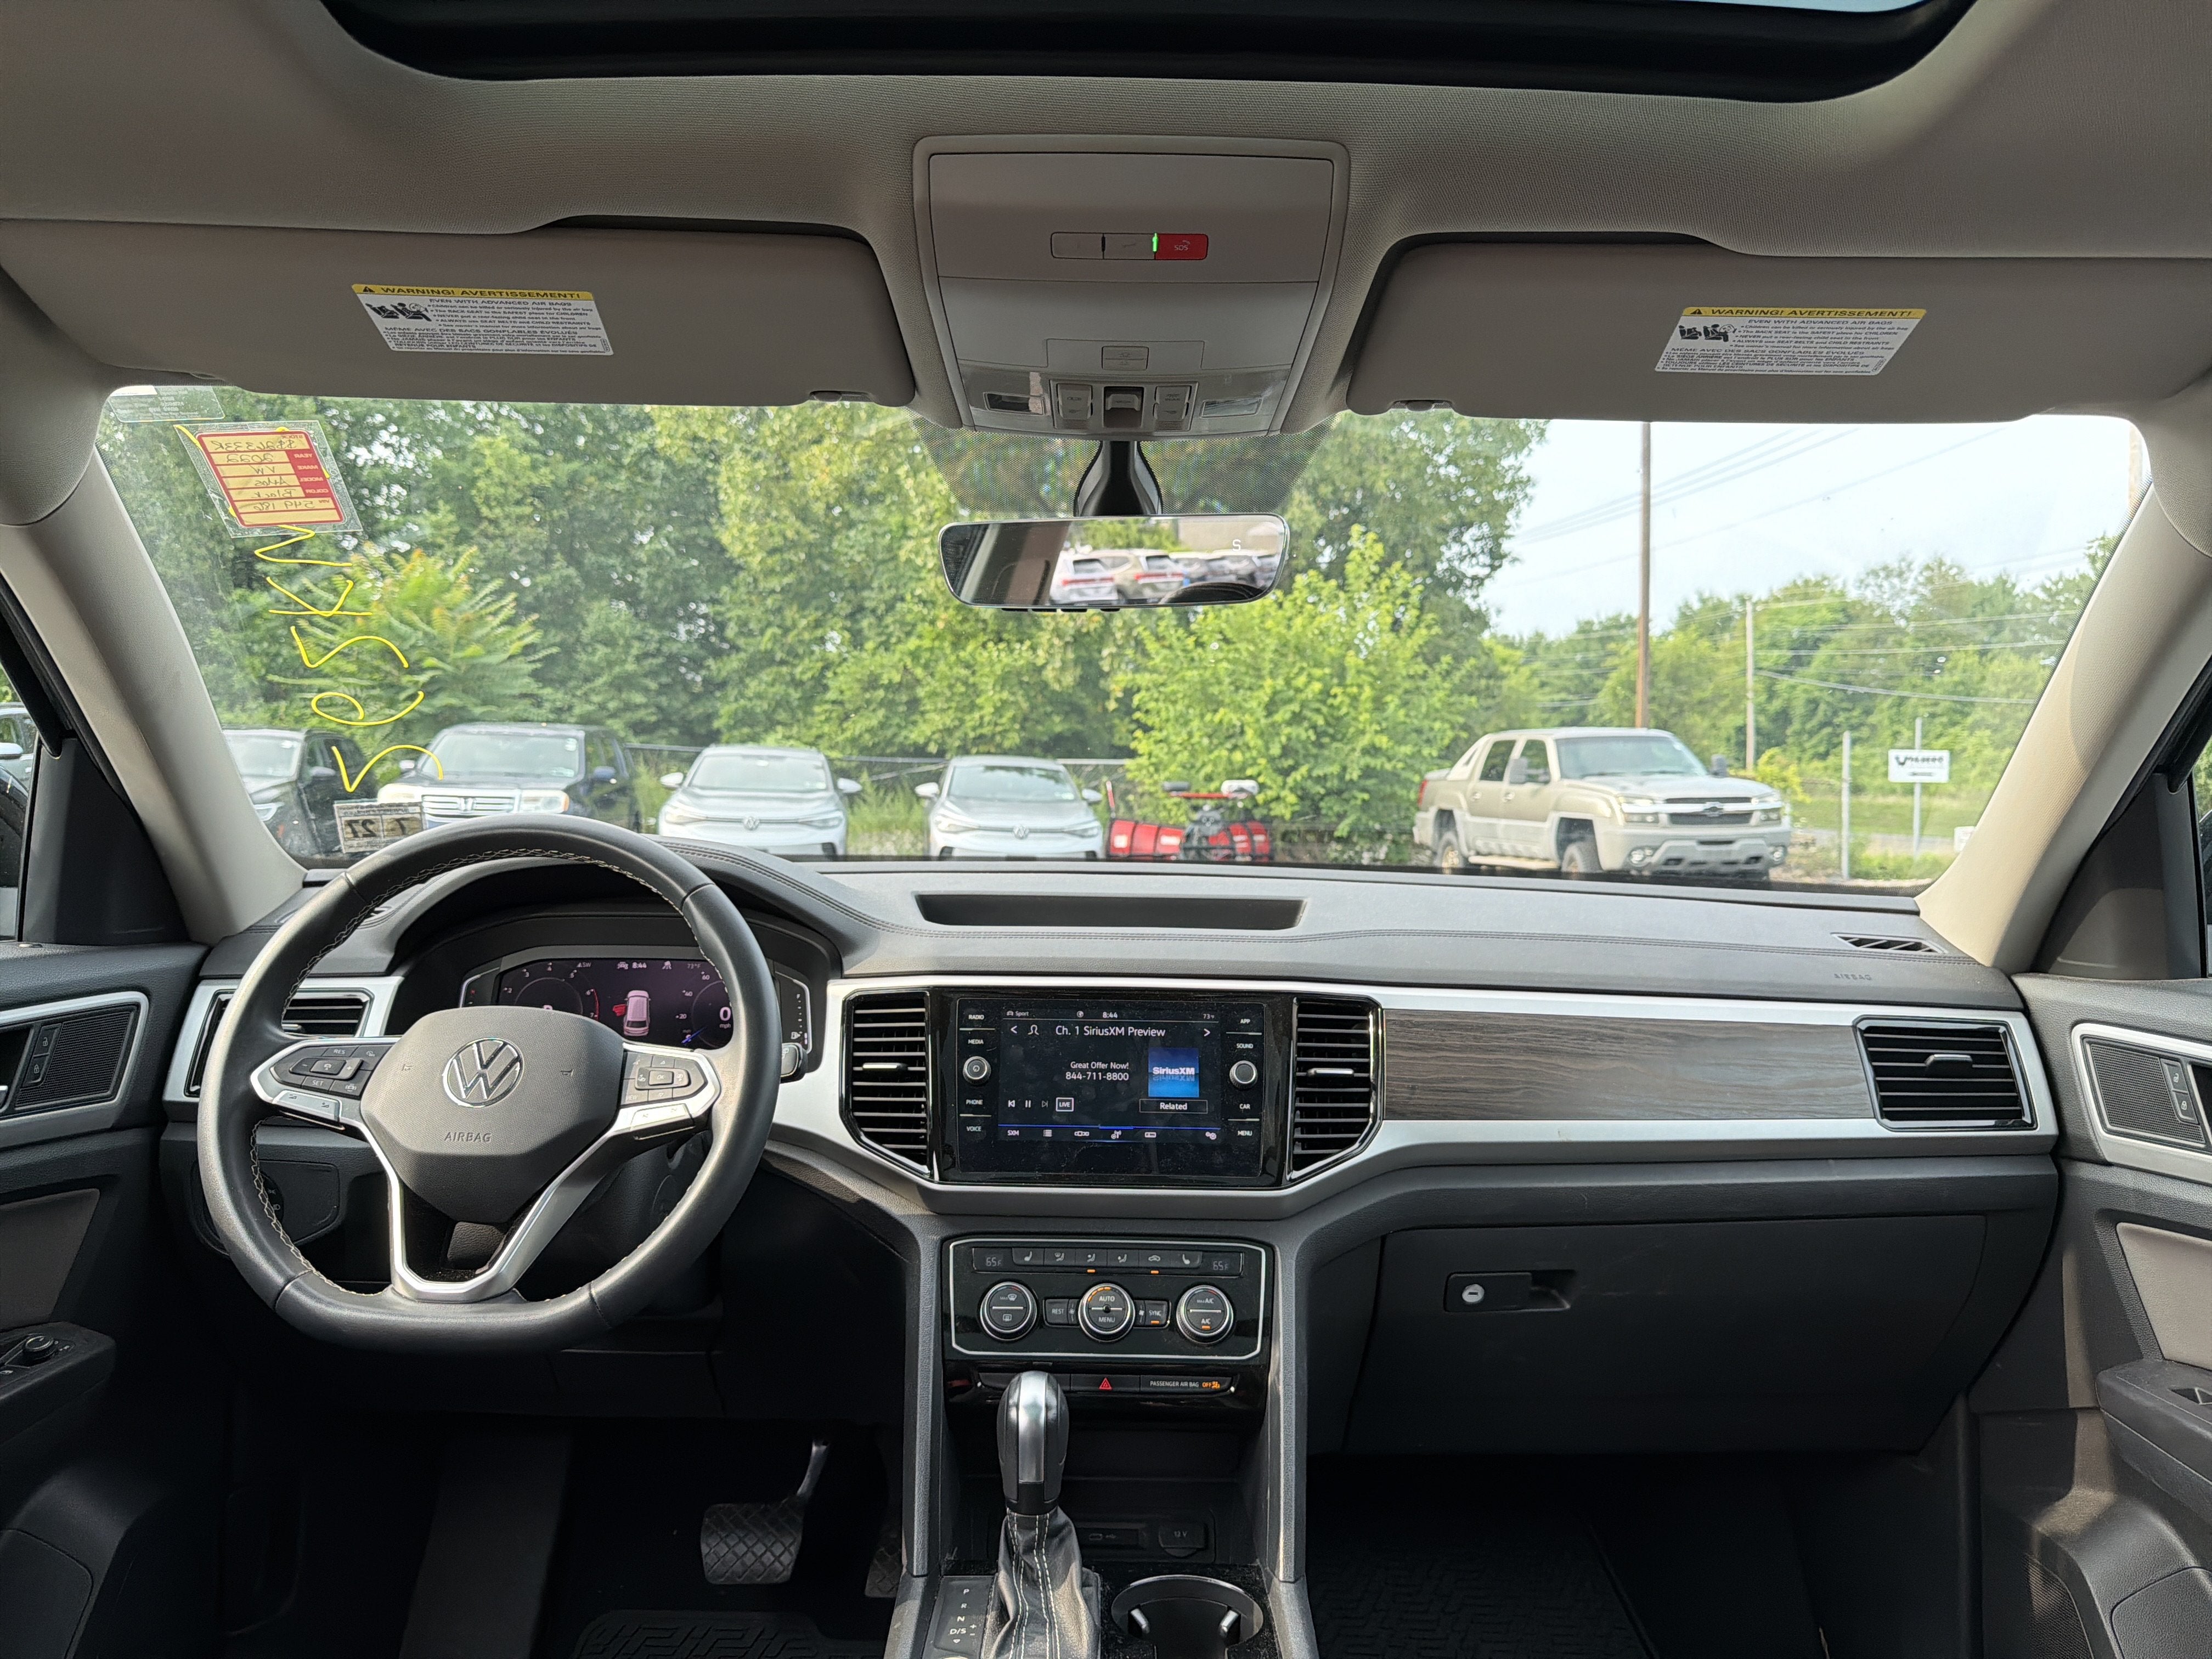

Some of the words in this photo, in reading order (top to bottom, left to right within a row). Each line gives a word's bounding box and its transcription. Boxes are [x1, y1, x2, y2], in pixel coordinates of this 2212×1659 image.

[381, 287, 455, 295] WARNING!
[460, 290, 580, 299] AVERTISSEMENT!
[1232, 539, 1242, 551] S
[719, 1006, 731, 1021] 0
[1055, 1025, 1071, 1036] Ch.
[1074, 1026, 1080, 1035] 1
[1083, 1026, 1125, 1036] SiriusXM
[1127, 1026, 1166, 1037] Preview
[1070, 1062, 1089, 1070] Great
[1090, 1062, 1108, 1070] Offer
[1109, 1062, 1129, 1070] Now!
[1152, 1066, 1195, 1075] SiriusXM
[1065, 1071, 1130, 1081] 844-711-8800
[1159, 1102, 1188, 1111] Related
[444, 1131, 493, 1143] AIRBAG
